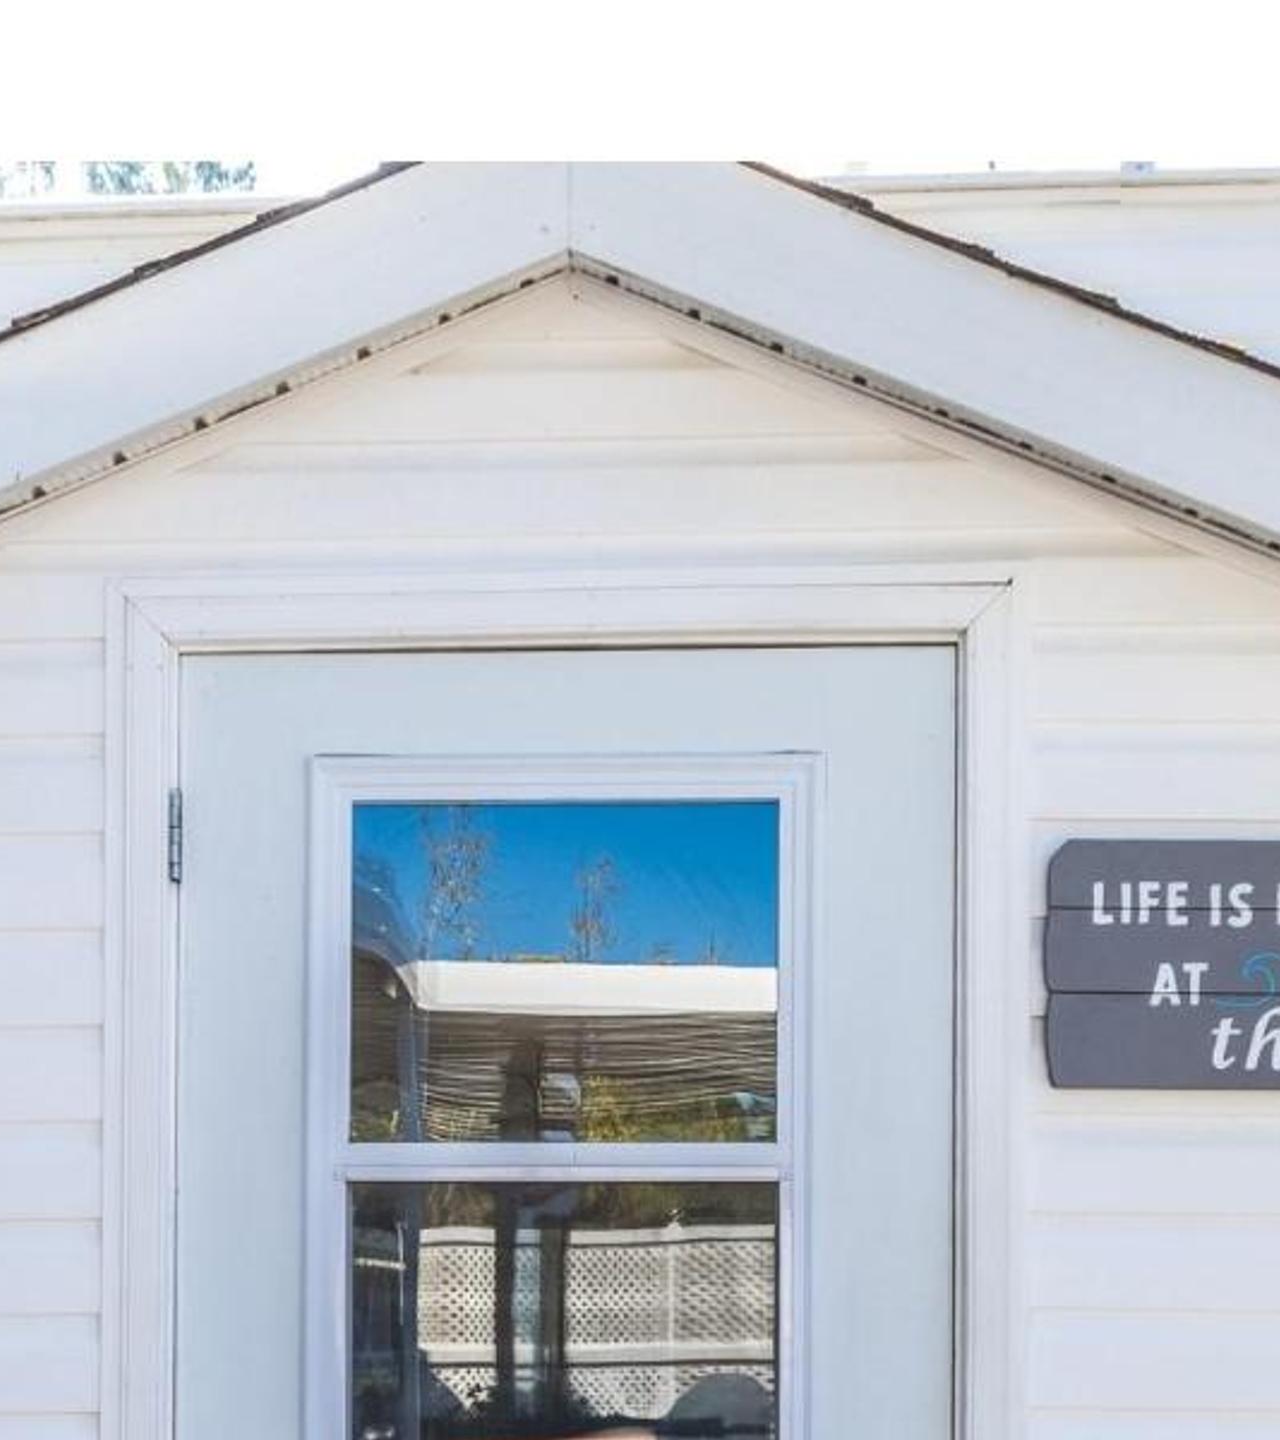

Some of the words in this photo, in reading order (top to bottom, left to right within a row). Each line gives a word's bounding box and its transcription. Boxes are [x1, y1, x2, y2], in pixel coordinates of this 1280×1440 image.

[1091, 880, 1190, 926] LIFE
[1209, 882, 1255, 928] IS
[1148, 962, 1209, 1007] AT
